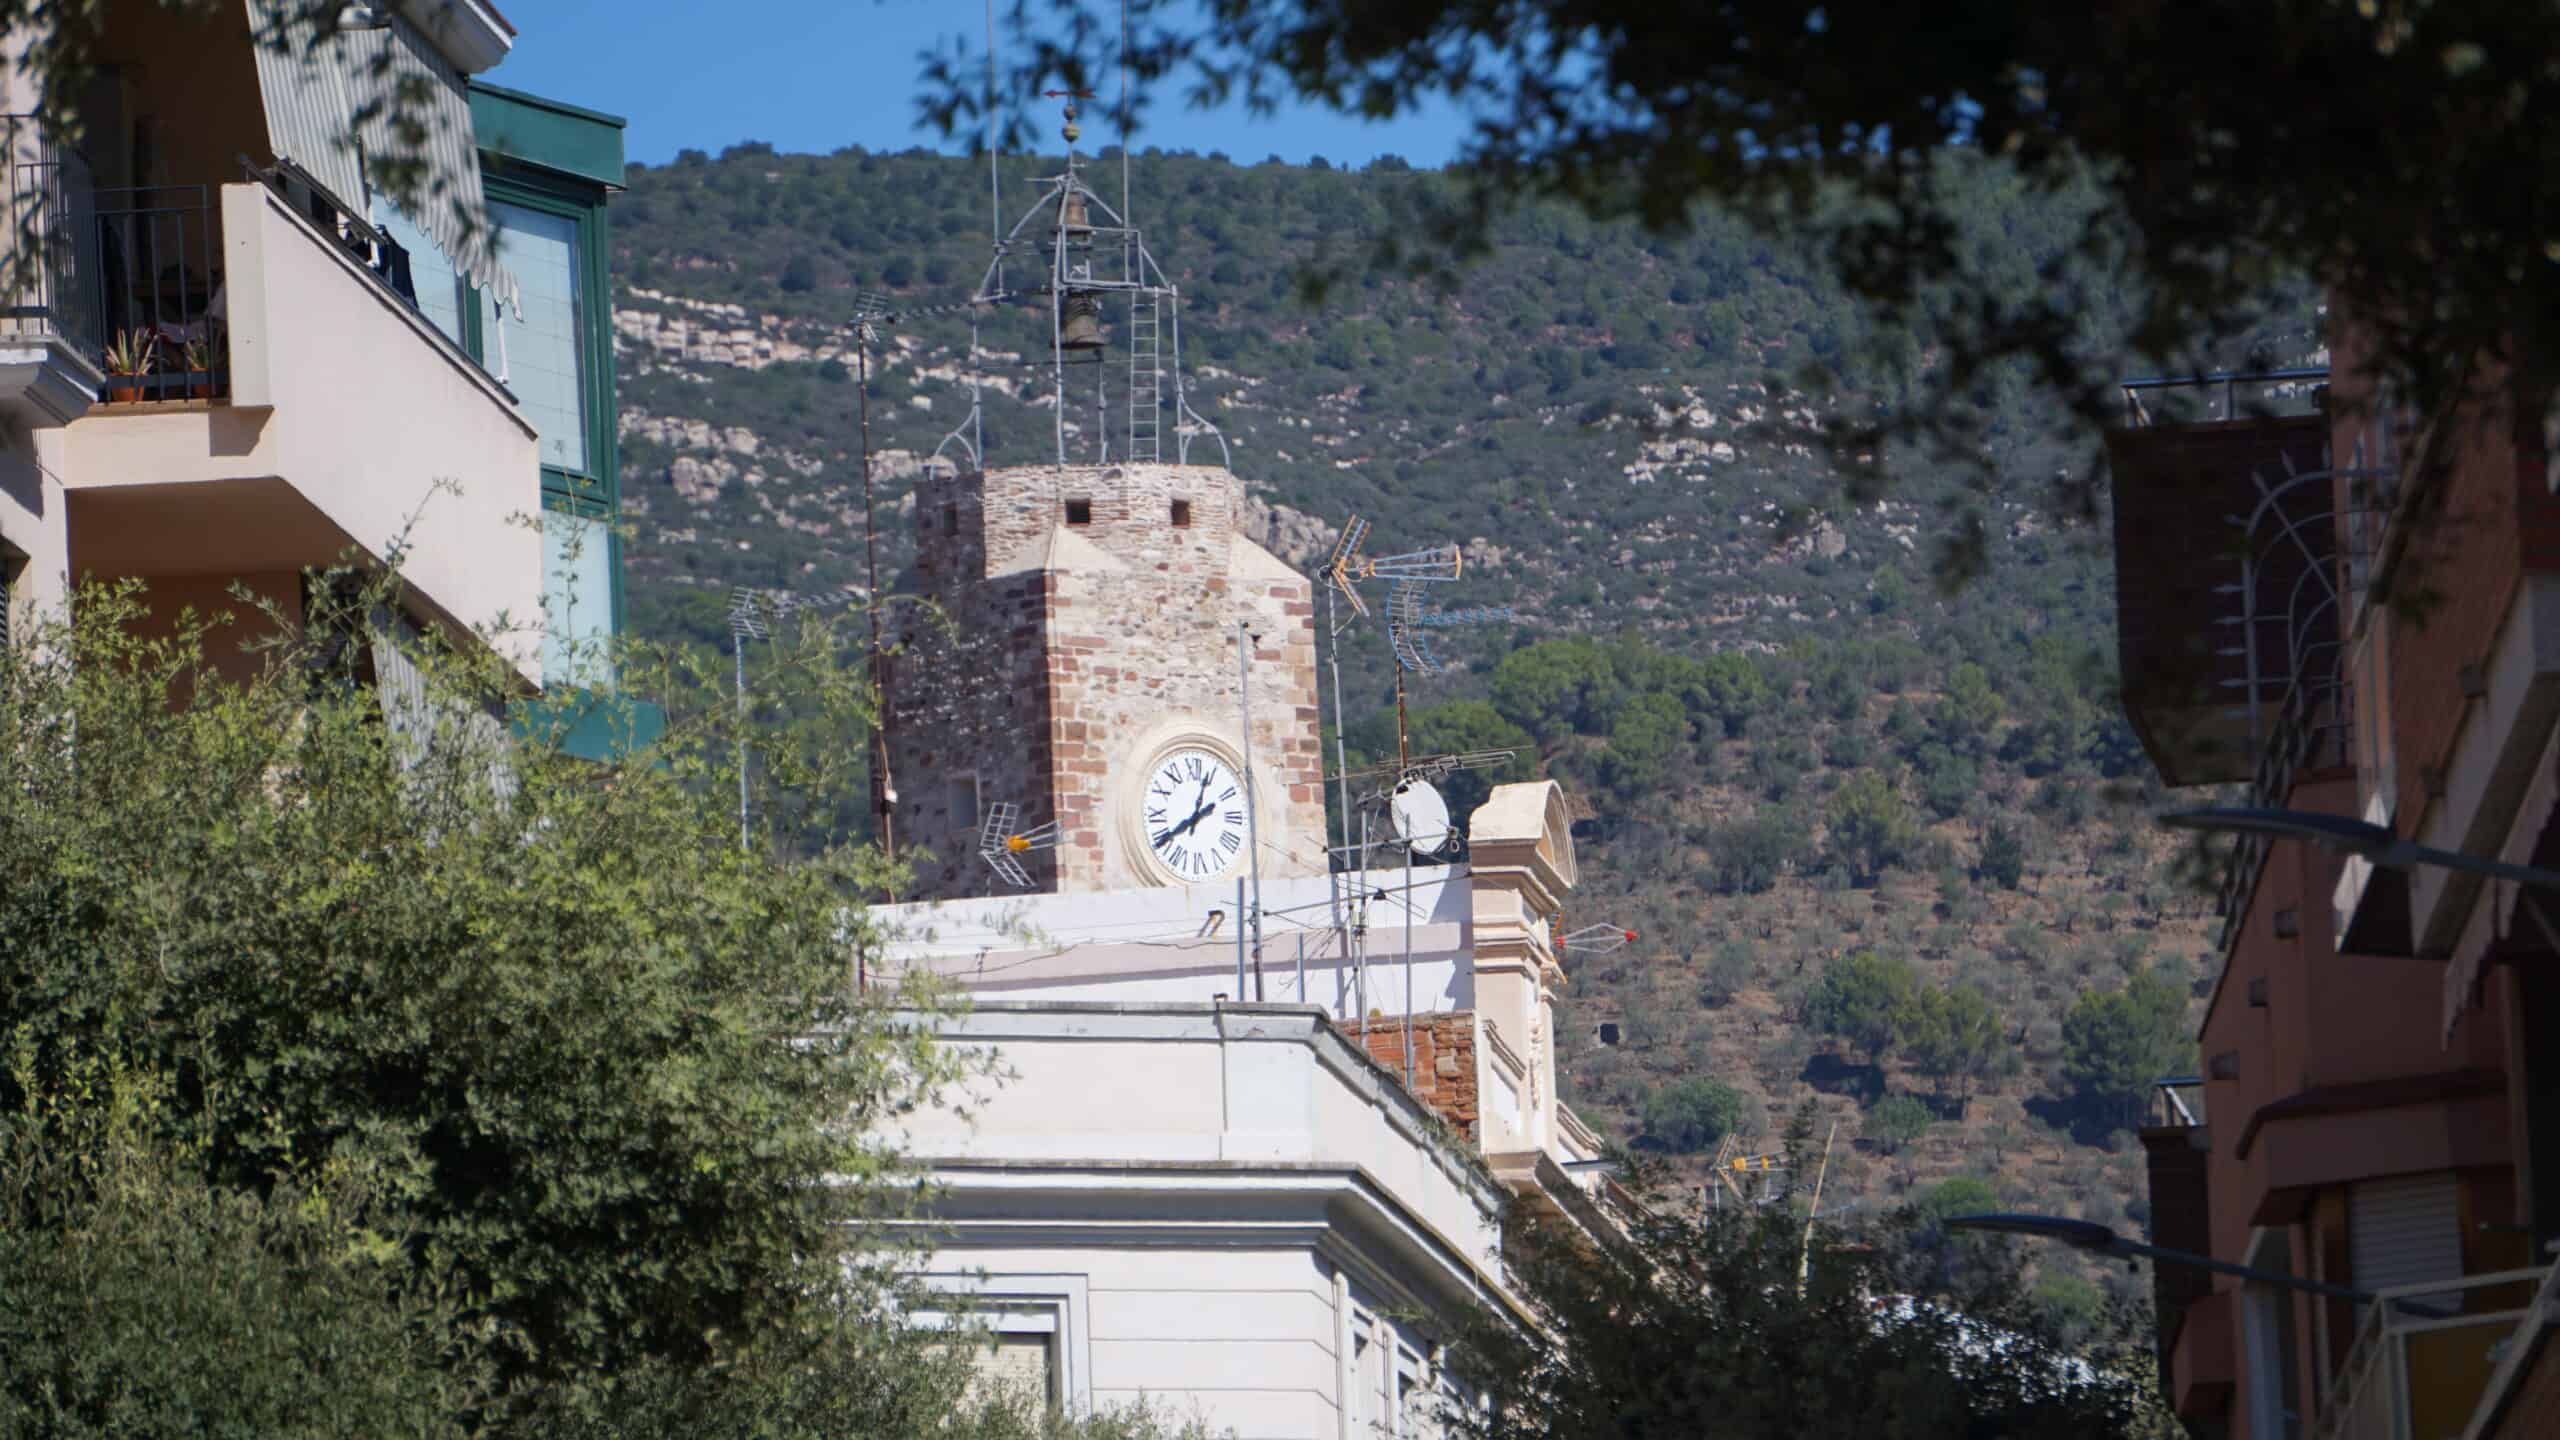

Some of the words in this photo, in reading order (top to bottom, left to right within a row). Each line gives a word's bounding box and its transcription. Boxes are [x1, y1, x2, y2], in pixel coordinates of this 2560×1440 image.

[1152, 780, 1171, 802] X
[1218, 786, 1236, 801] II
[1148, 806, 1167, 823] IX
[1224, 810, 1242, 825] III
[1219, 830, 1241, 854] IIII
[1211, 848, 1226, 871] V
